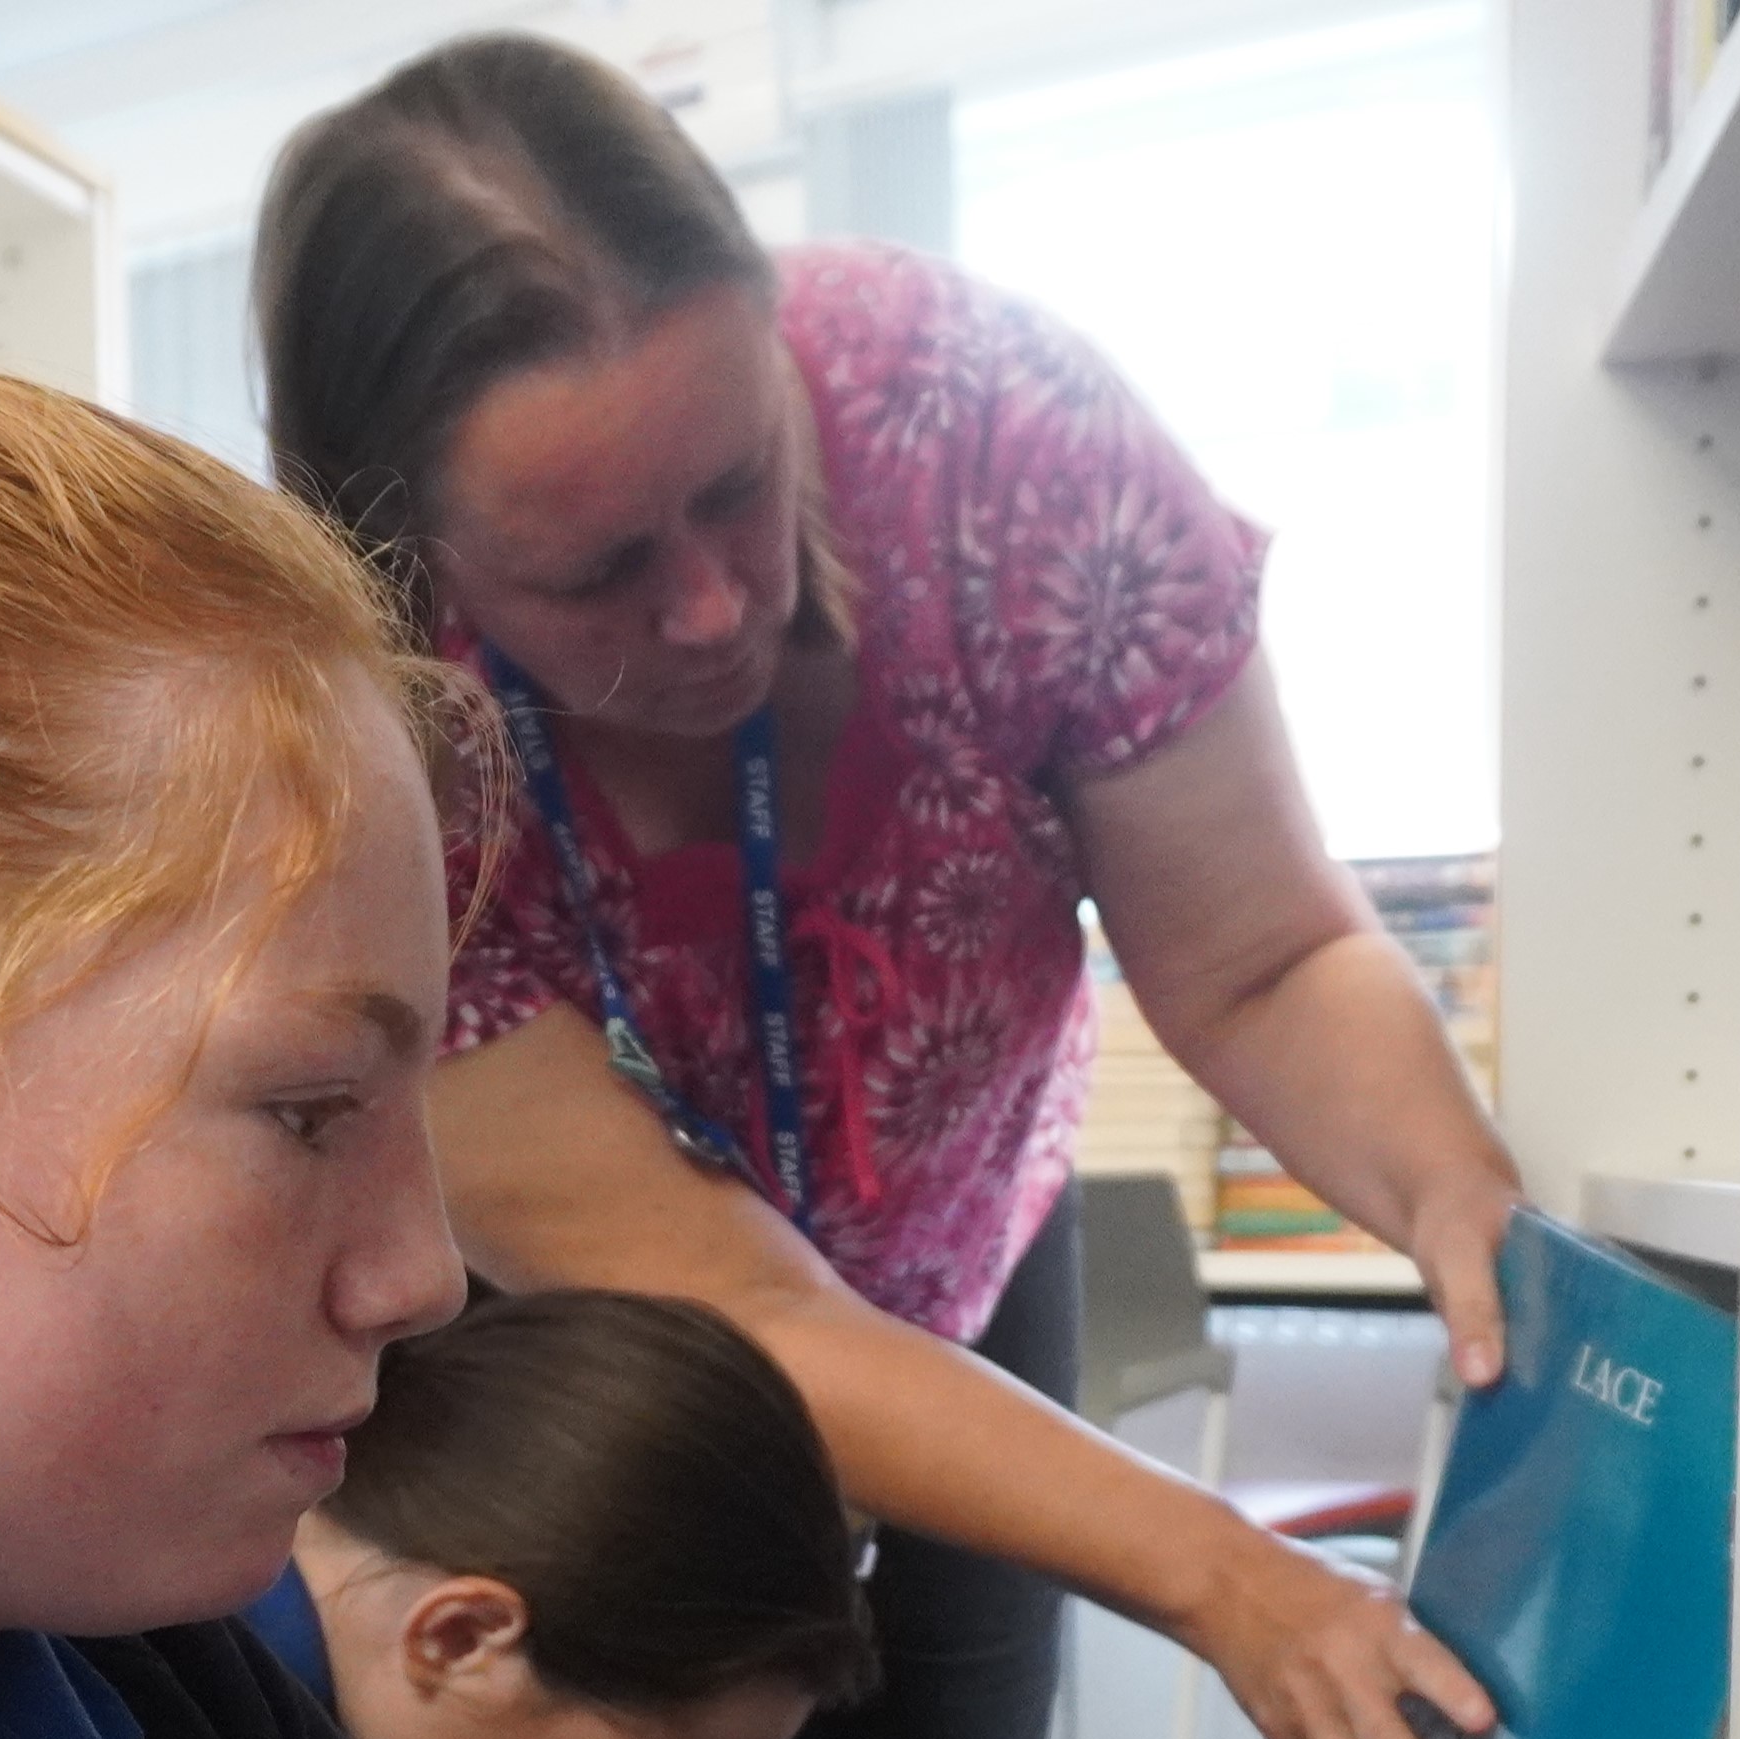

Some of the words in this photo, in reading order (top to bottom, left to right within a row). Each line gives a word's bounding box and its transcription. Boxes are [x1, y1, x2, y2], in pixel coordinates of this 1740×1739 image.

[746, 757, 772, 839] STAFF
[751, 890, 781, 967] STAFF
[766, 1012, 793, 1088] STAFF
[778, 1131, 803, 1202] STAFF
[1570, 1342, 1665, 1428] LACE
